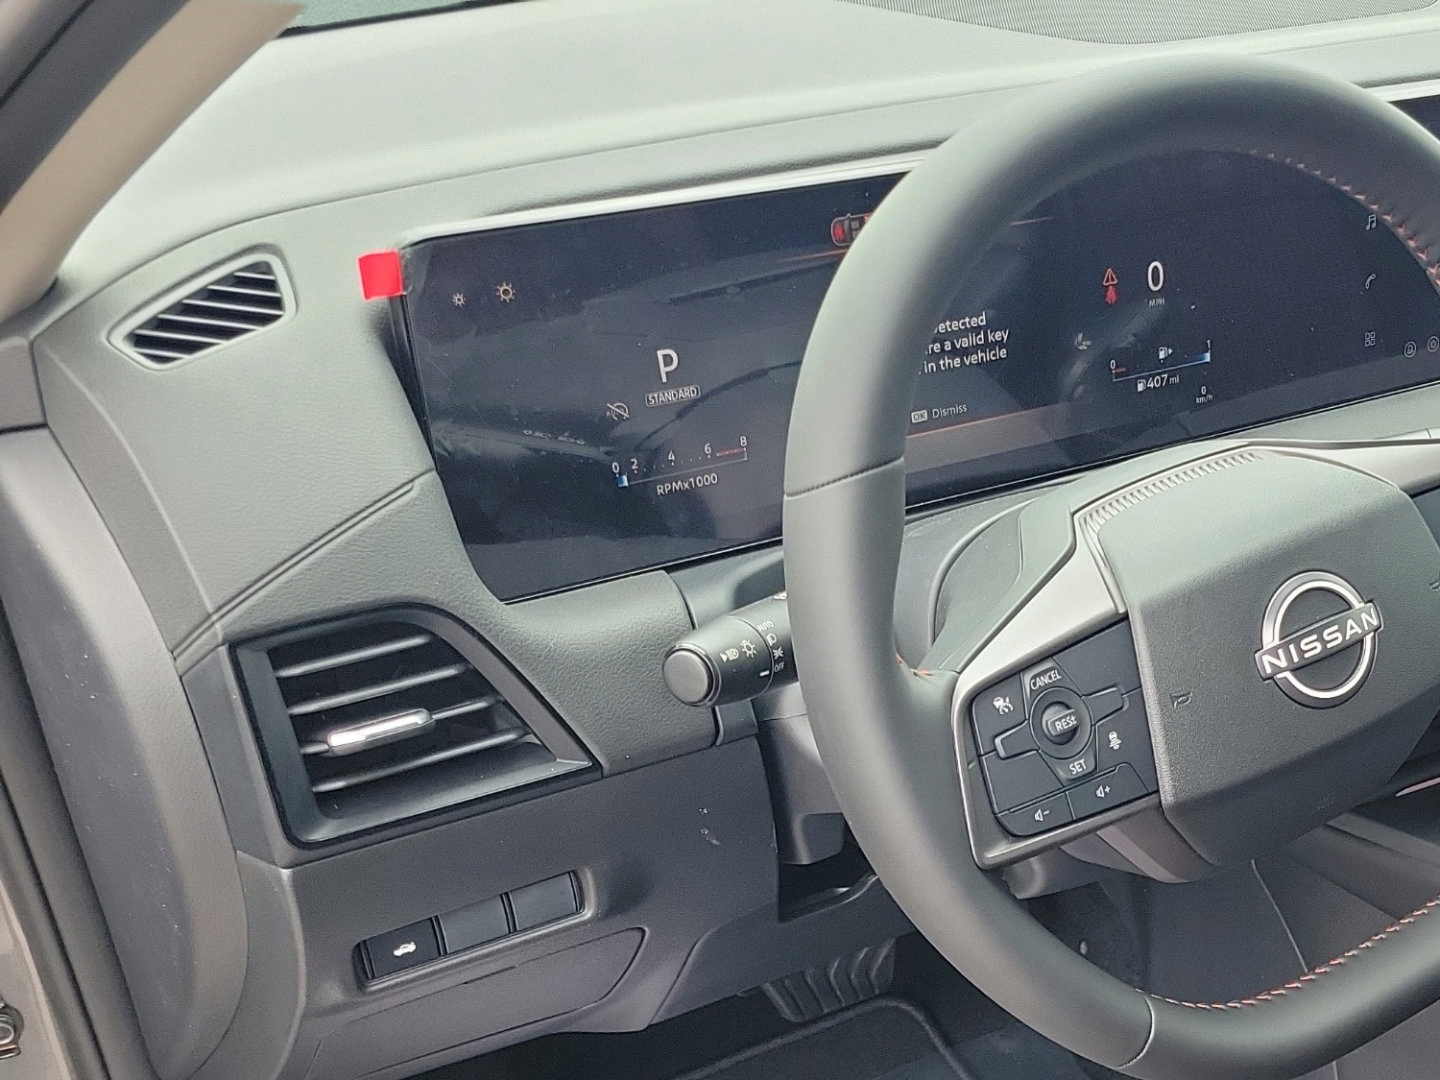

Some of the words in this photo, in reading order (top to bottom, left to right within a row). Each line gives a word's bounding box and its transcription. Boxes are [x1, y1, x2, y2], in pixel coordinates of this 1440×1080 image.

[1148, 261, 1164, 292] 0
[954, 330, 985, 349] valid
[987, 329, 1009, 343] key
[656, 349, 679, 383] P
[924, 361, 936, 374] in
[939, 356, 961, 371] the
[964, 346, 1007, 366] vehicle
[1147, 374, 1168, 390] 407
[648, 387, 698, 405] STANDARD
[932, 404, 968, 419] Dismiss
[656, 472, 718, 496] RPMx1000
[1260, 606, 1380, 676] NISSAN
[774, 661, 785, 673] OFF
[1030, 669, 1062, 690] CANCEL
[1069, 758, 1087, 775] SET
